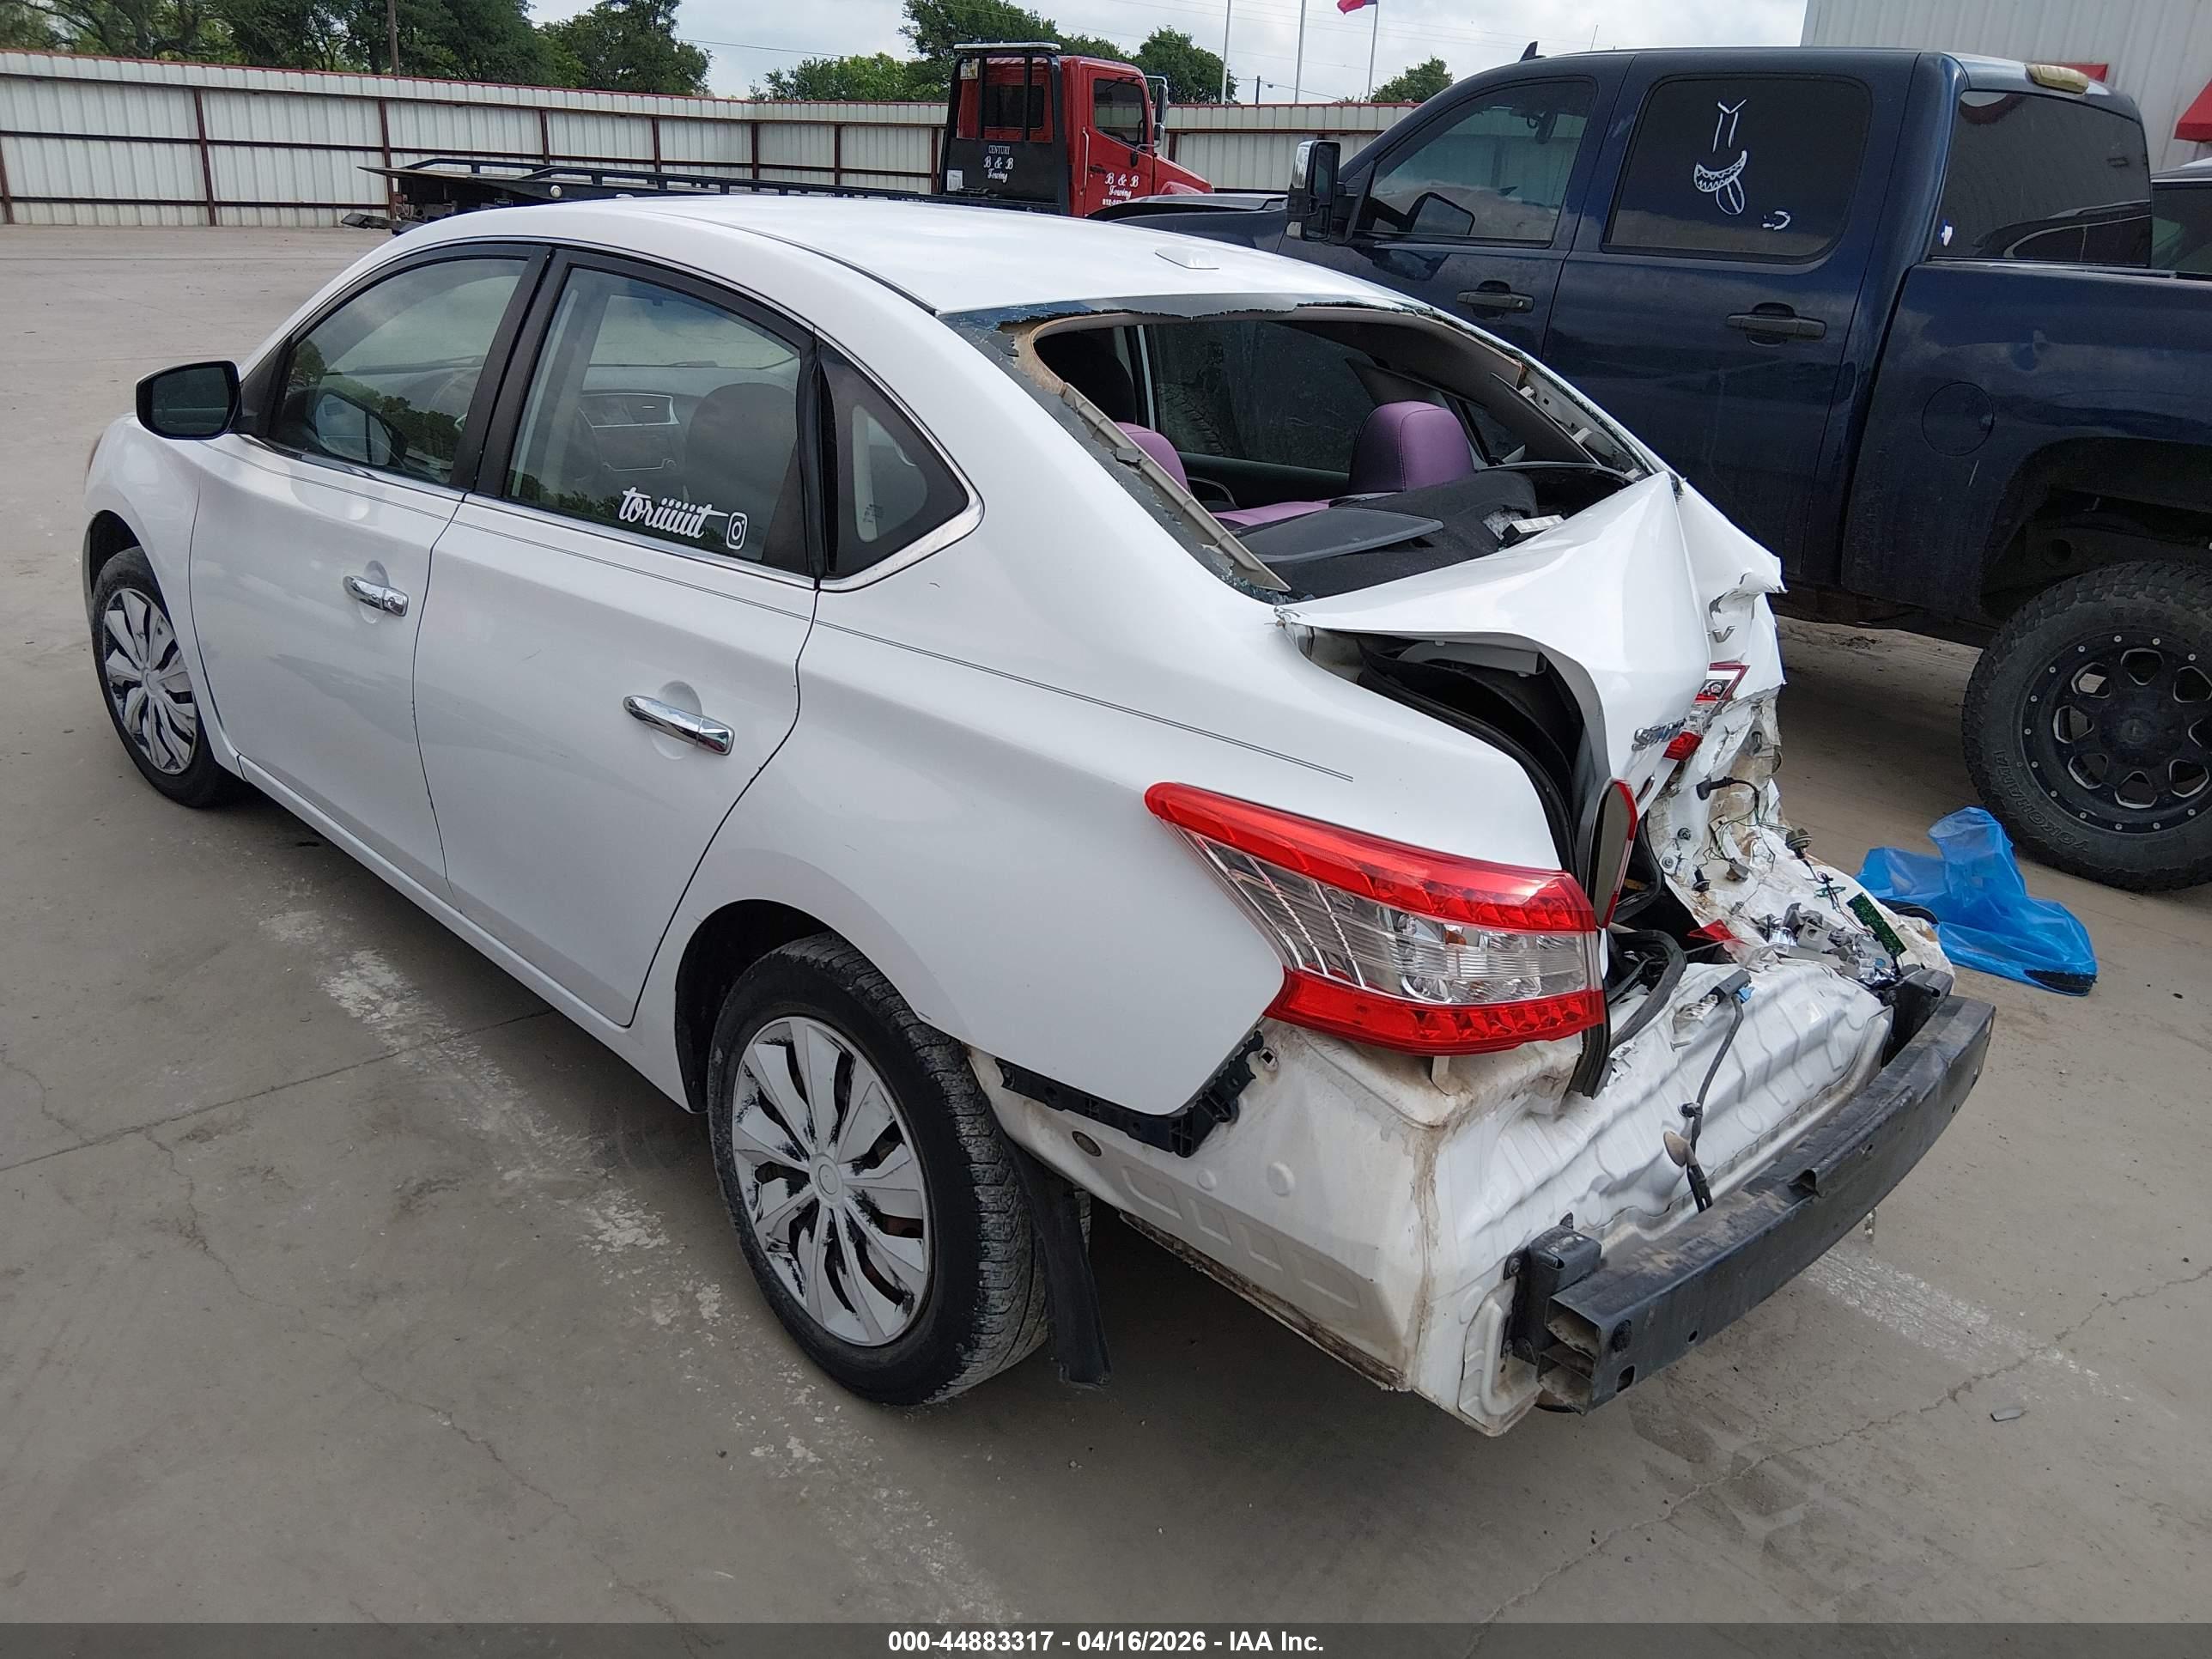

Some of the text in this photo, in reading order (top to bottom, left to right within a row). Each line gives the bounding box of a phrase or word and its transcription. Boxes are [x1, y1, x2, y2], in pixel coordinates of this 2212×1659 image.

[983, 155, 1014, 170] B & B
[988, 167, 1008, 184] Towing
[1104, 172, 1139, 188] B & B
[1109, 185, 1132, 200] Towing
[1993, 749, 2091, 853] YOKOHAMA
